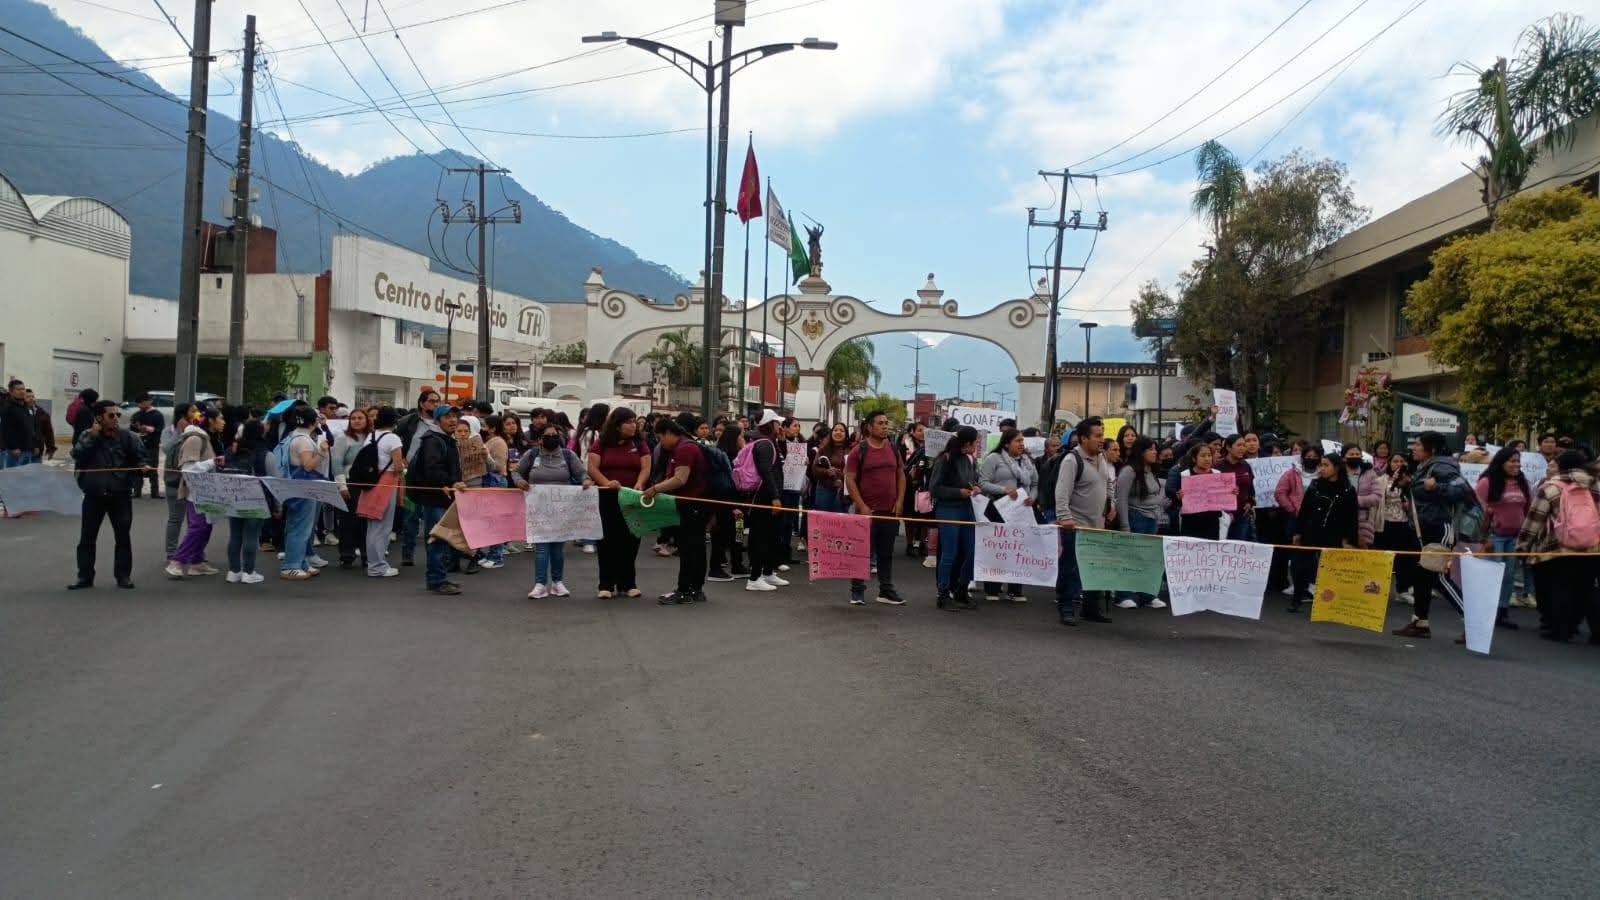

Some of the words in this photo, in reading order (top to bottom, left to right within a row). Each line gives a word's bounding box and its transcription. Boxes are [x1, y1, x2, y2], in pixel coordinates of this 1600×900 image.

[374, 271, 432, 312] Centro
[518, 307, 543, 337] LTH
[1012, 527, 1025, 538] es
